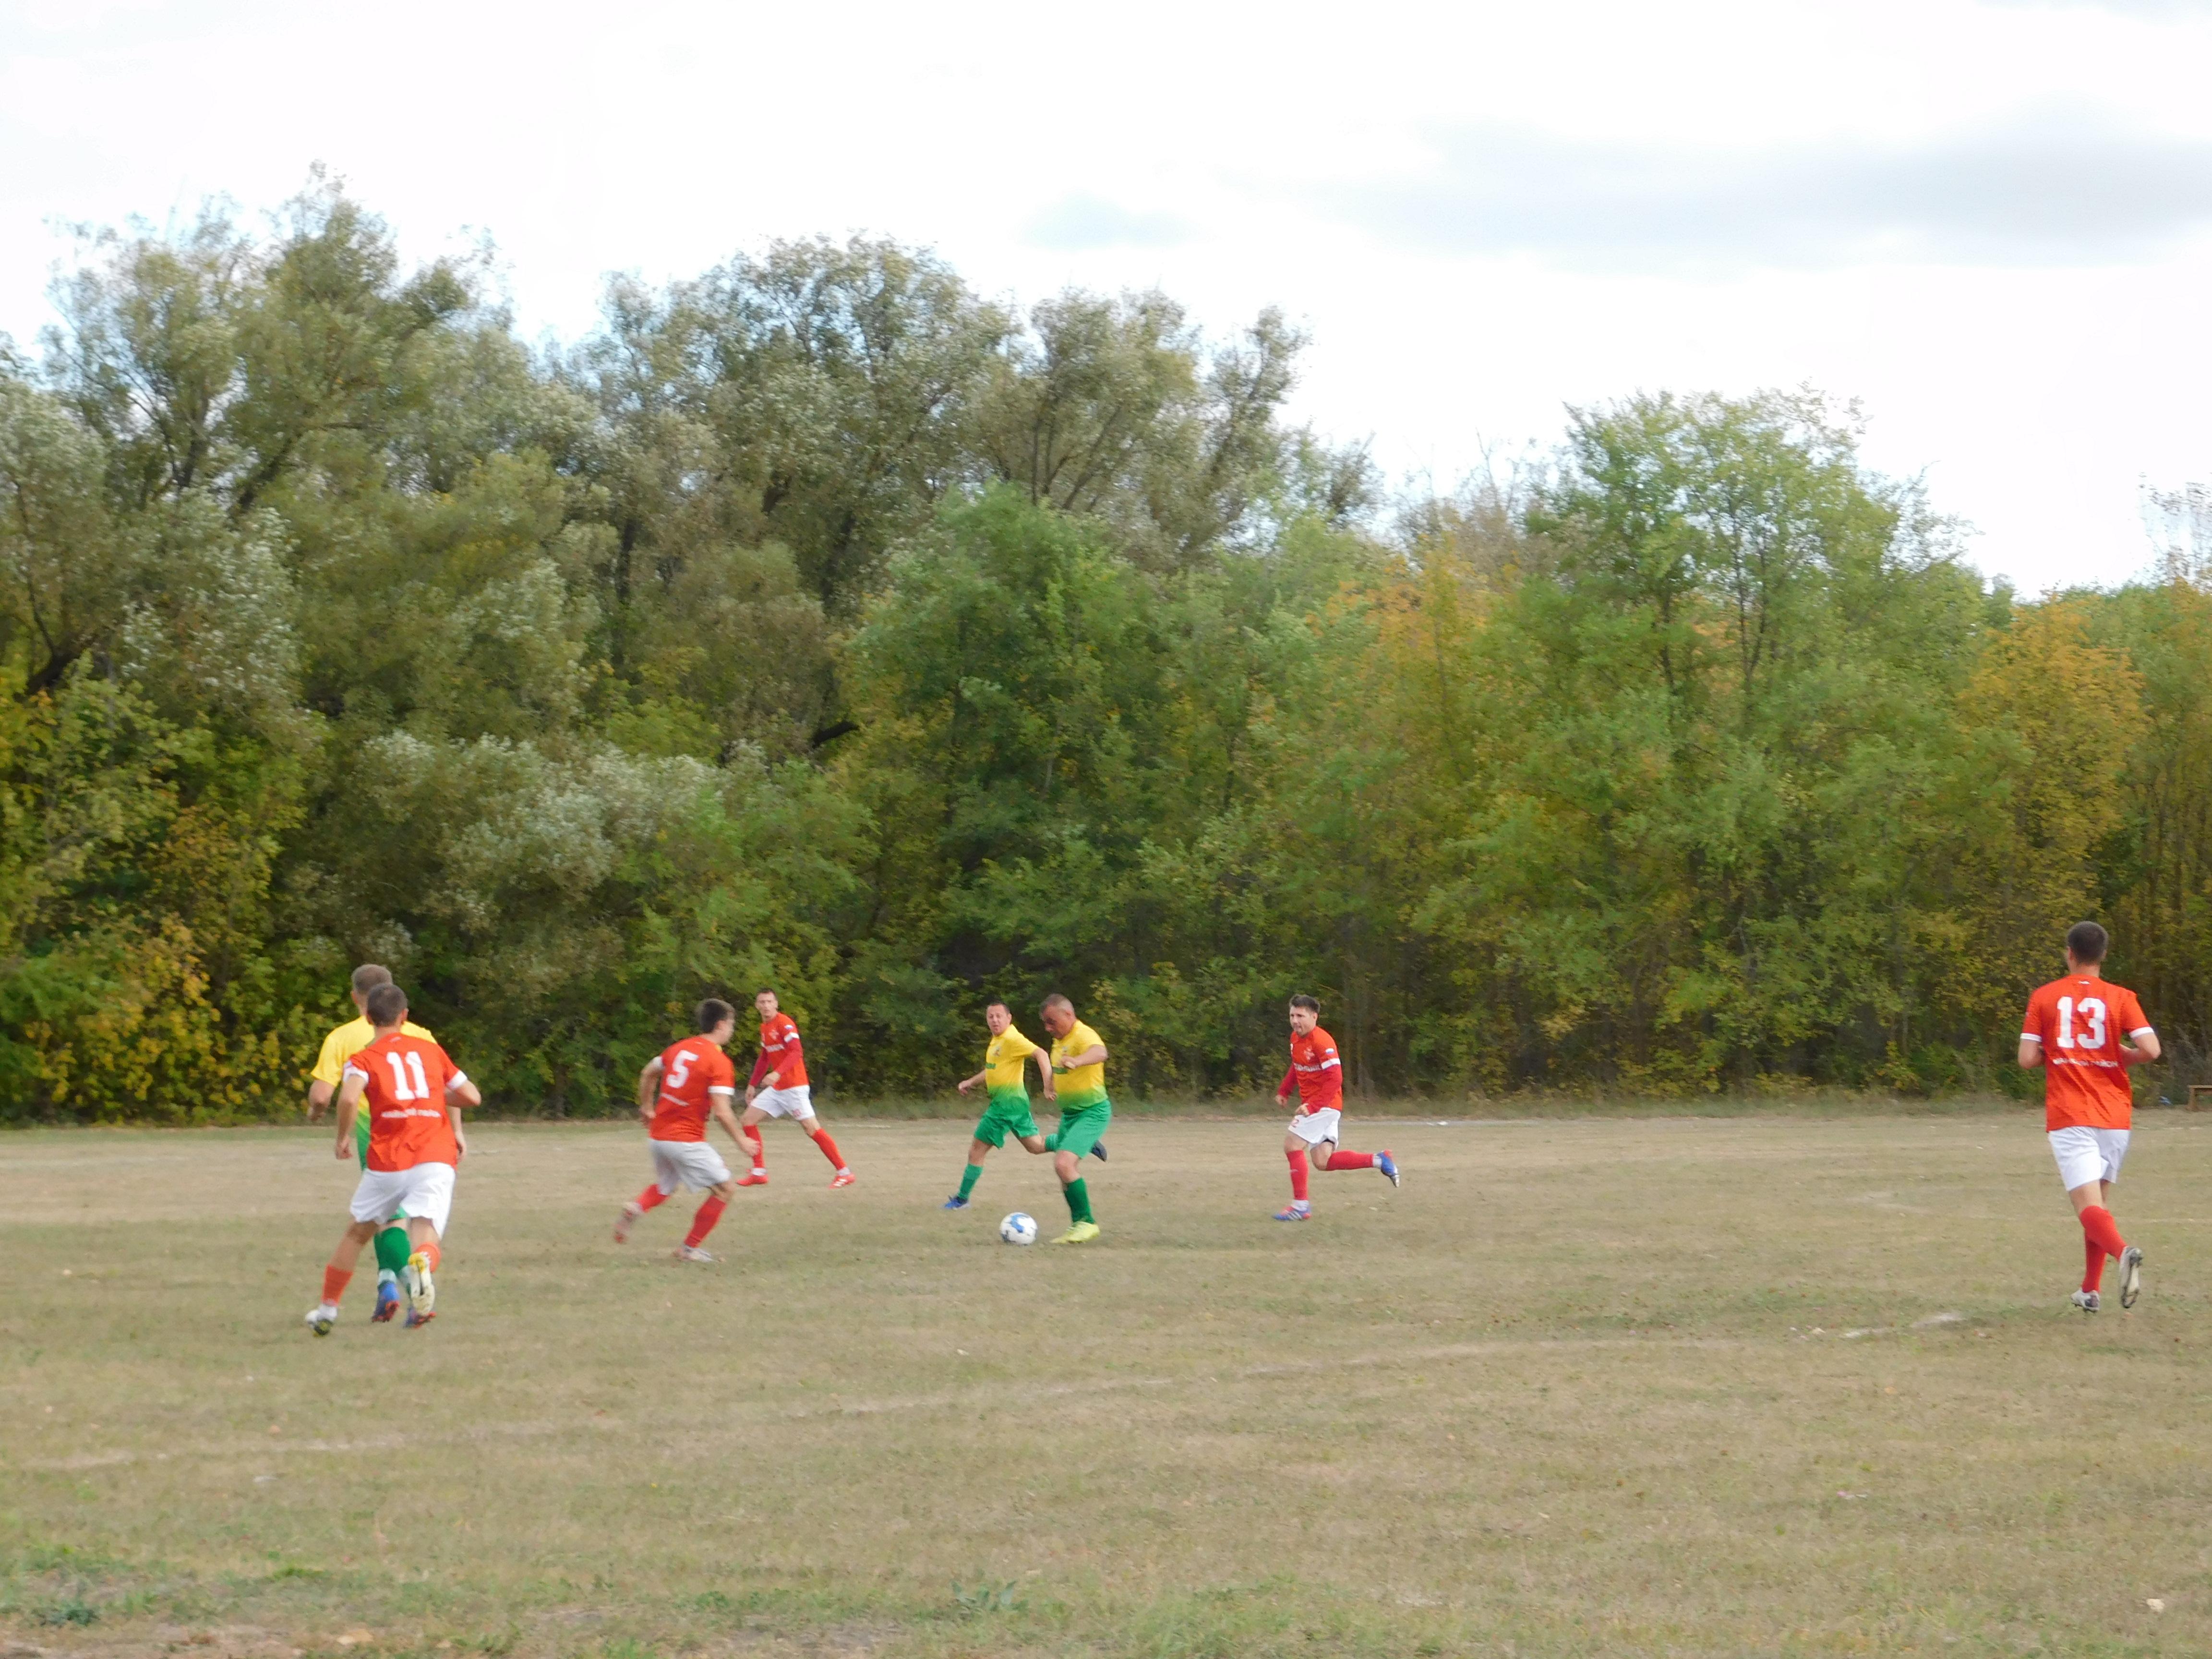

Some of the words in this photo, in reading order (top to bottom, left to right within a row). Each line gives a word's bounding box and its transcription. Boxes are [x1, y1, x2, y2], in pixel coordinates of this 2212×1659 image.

[2056, 996, 2105, 1048] 13
[386, 1050, 430, 1100] 11
[666, 1049, 699, 1089] 5
